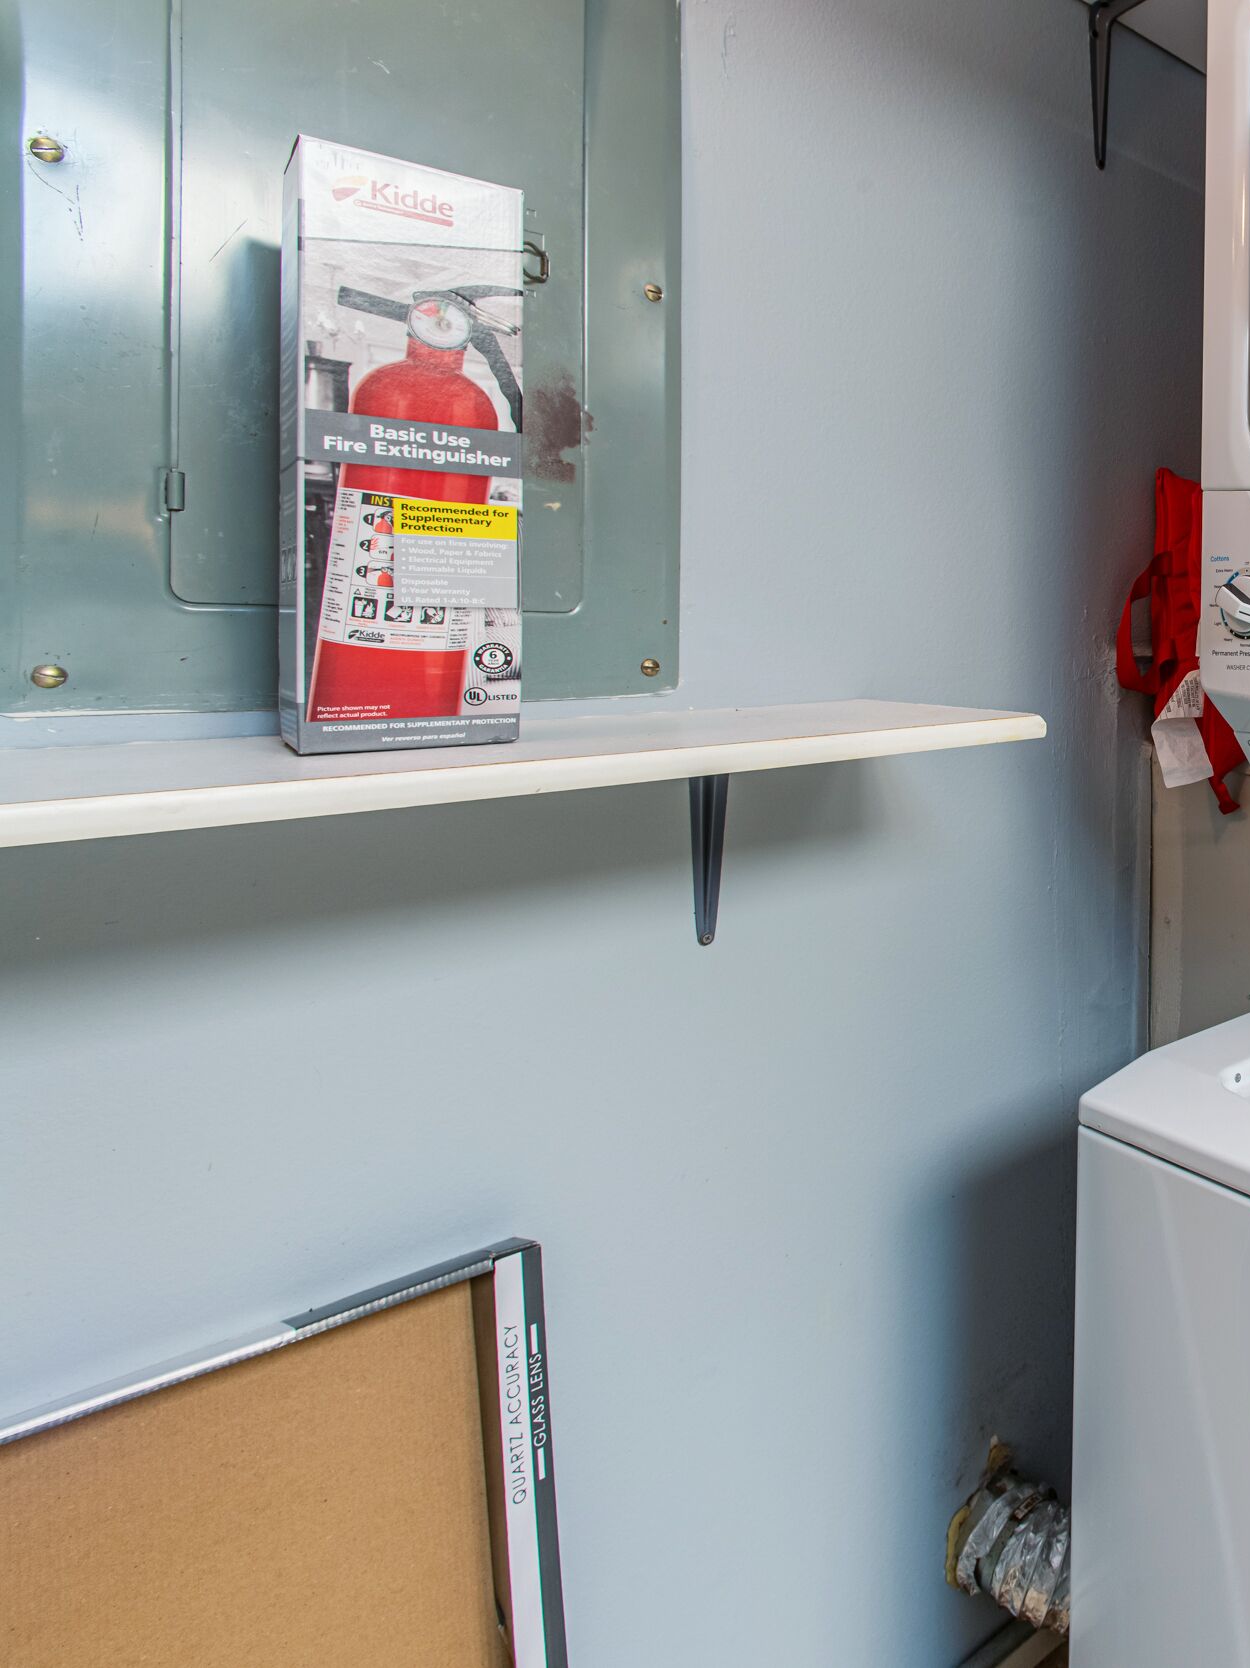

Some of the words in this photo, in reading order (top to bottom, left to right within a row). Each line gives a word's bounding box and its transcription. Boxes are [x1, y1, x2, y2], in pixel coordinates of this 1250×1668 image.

[370, 179, 454, 218] Kidde
[370, 423, 427, 444] Basic
[433, 430, 471, 448] Use
[323, 435, 367, 454] Fire
[374, 441, 511, 467] Extinguisher
[401, 503, 489, 517] Recommended
[492, 509, 509, 518] for
[401, 512, 492, 528] Supplementary
[401, 522, 463, 533] Protection
[440, 548, 463, 556] Paper
[408, 556, 447, 564] Electrical
[449, 557, 494, 566] Equipment
[408, 565, 455, 573] Flammable
[457, 567, 487, 575] Liquids
[360, 629, 386, 639] Kidde
[489, 650, 497, 659] 6
[469, 690, 483, 702] UL
[322, 723, 387, 732] RECOMMENDED
[407, 719, 470, 728] SUPPLEMENTARY
[472, 717, 516, 725] PROTECTION
[504, 1326, 523, 1425] ACCURACY
[530, 1353, 544, 1393] LENS
[532, 1395, 547, 1448] GLASS
[510, 1432, 527, 1504] QUARTZ
